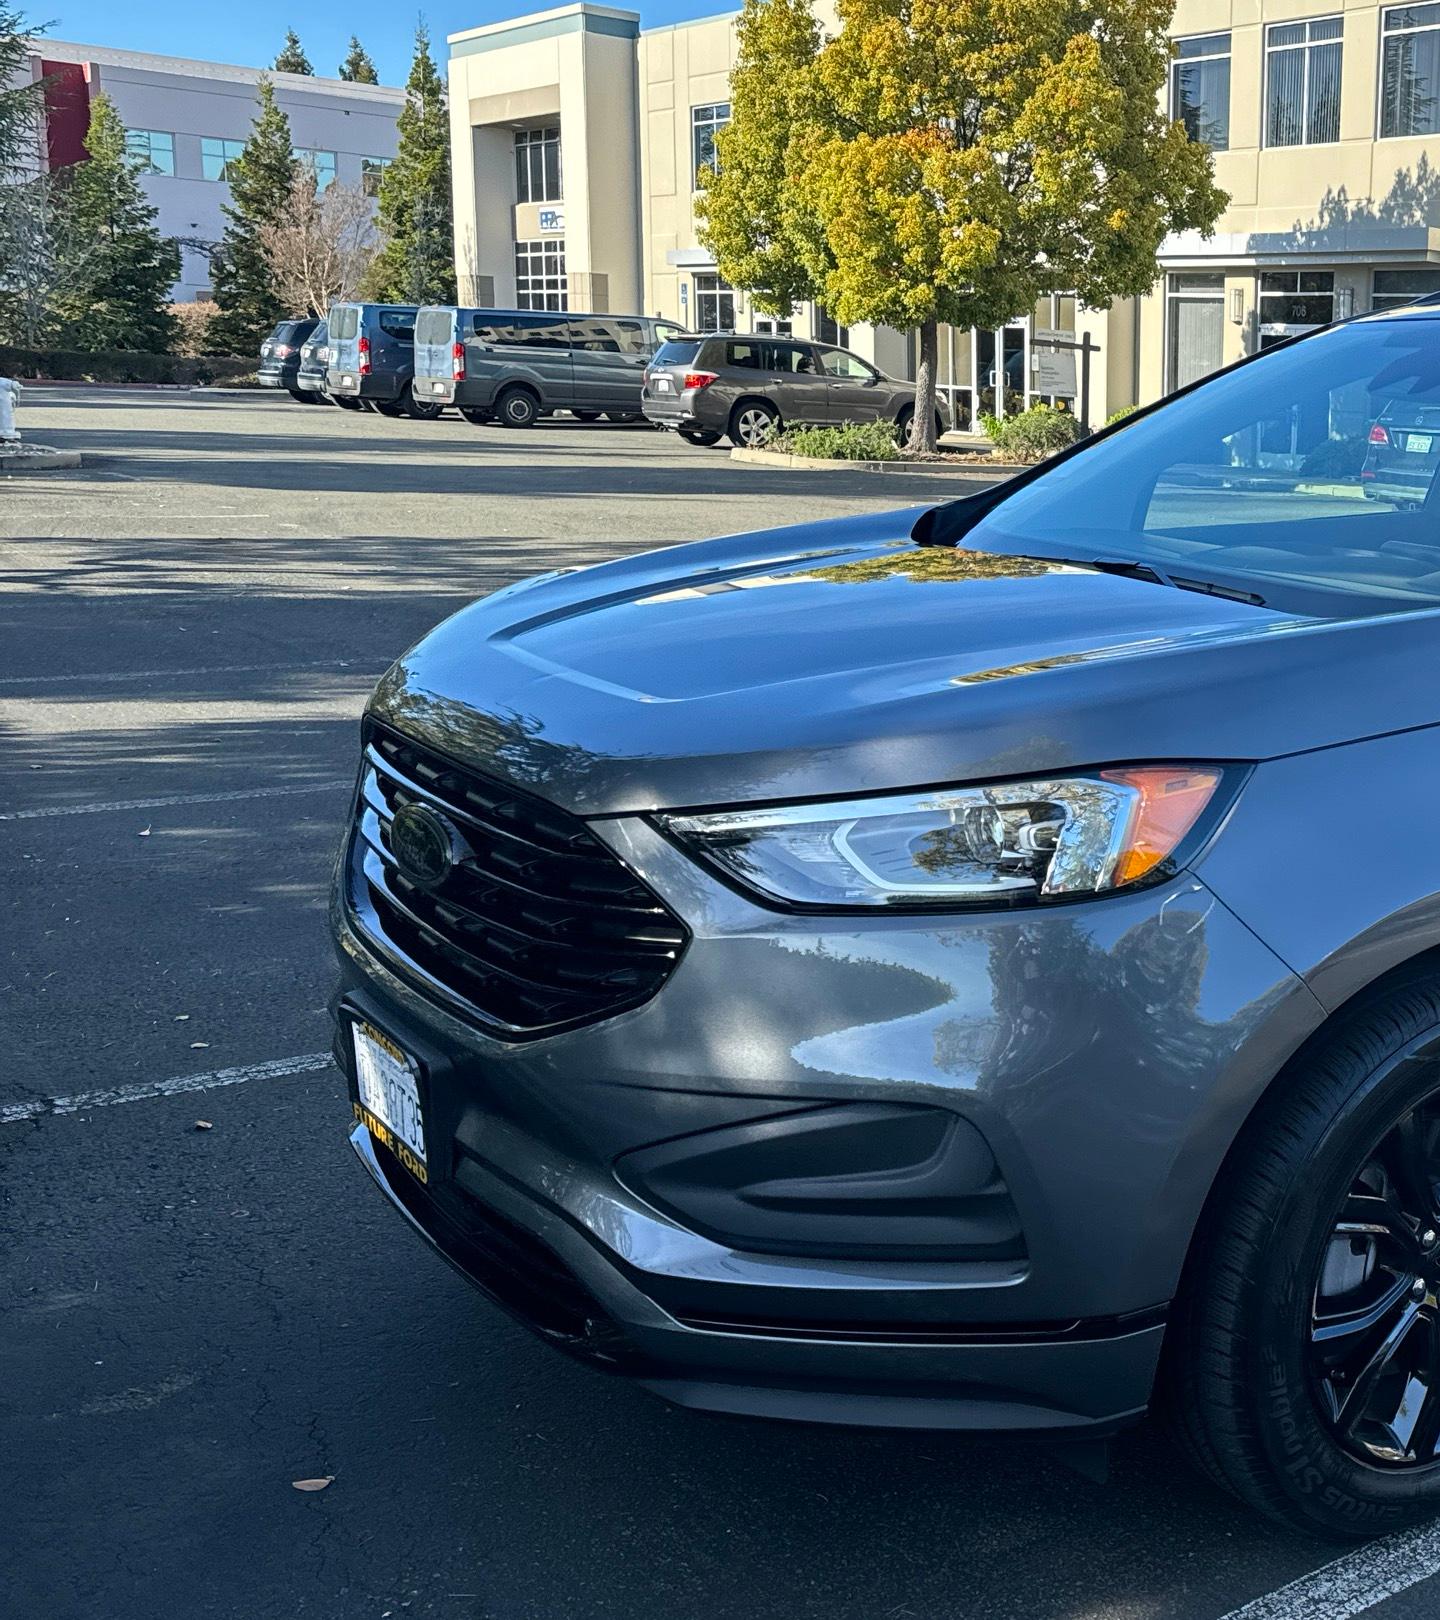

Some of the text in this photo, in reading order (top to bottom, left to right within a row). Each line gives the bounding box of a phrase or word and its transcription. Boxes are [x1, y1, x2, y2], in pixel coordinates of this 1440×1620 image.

[1291, 304, 1307, 317] 706
[353, 1102, 394, 1153] FUTURE
[397, 1141, 428, 1185] FORD
